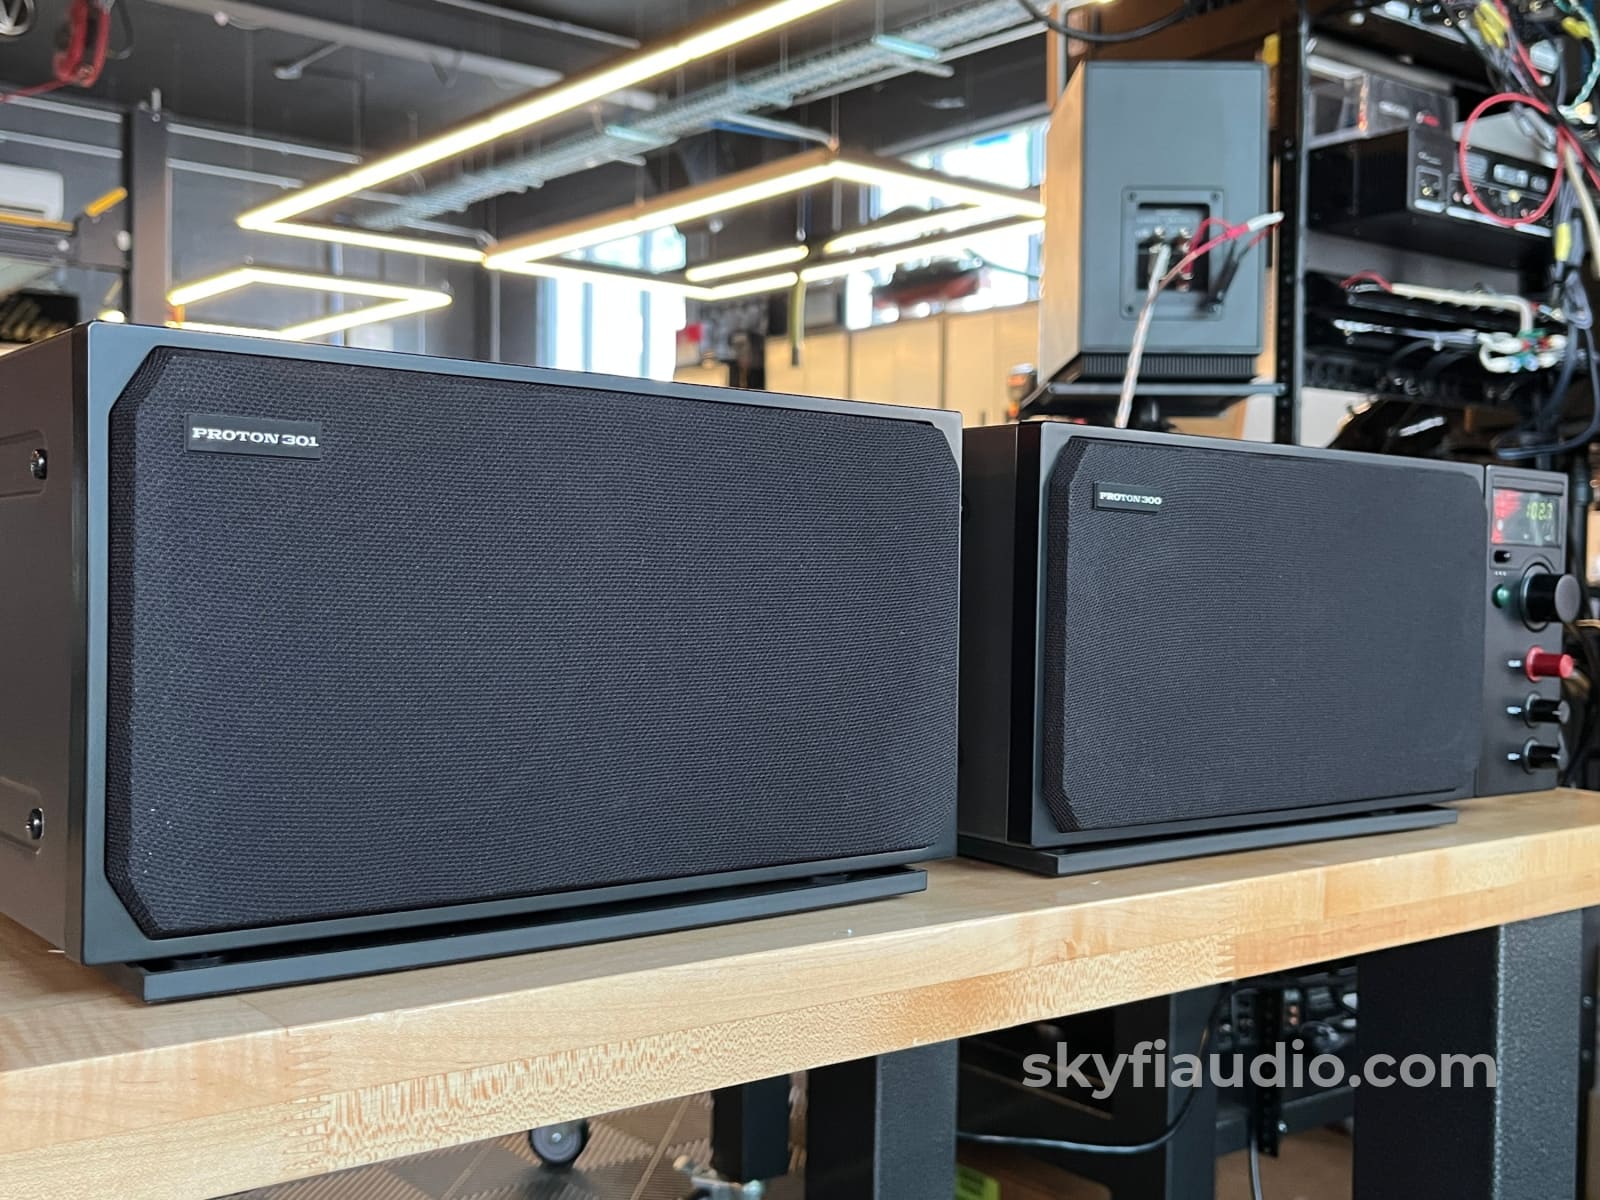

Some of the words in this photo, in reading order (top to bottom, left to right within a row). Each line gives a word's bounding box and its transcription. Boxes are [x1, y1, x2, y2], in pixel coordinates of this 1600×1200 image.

[192, 427, 280, 444] PROTON
[281, 434, 320, 447] 301
[1099, 492, 1140, 503] PROTON
[1141, 496, 1162, 504] 300
